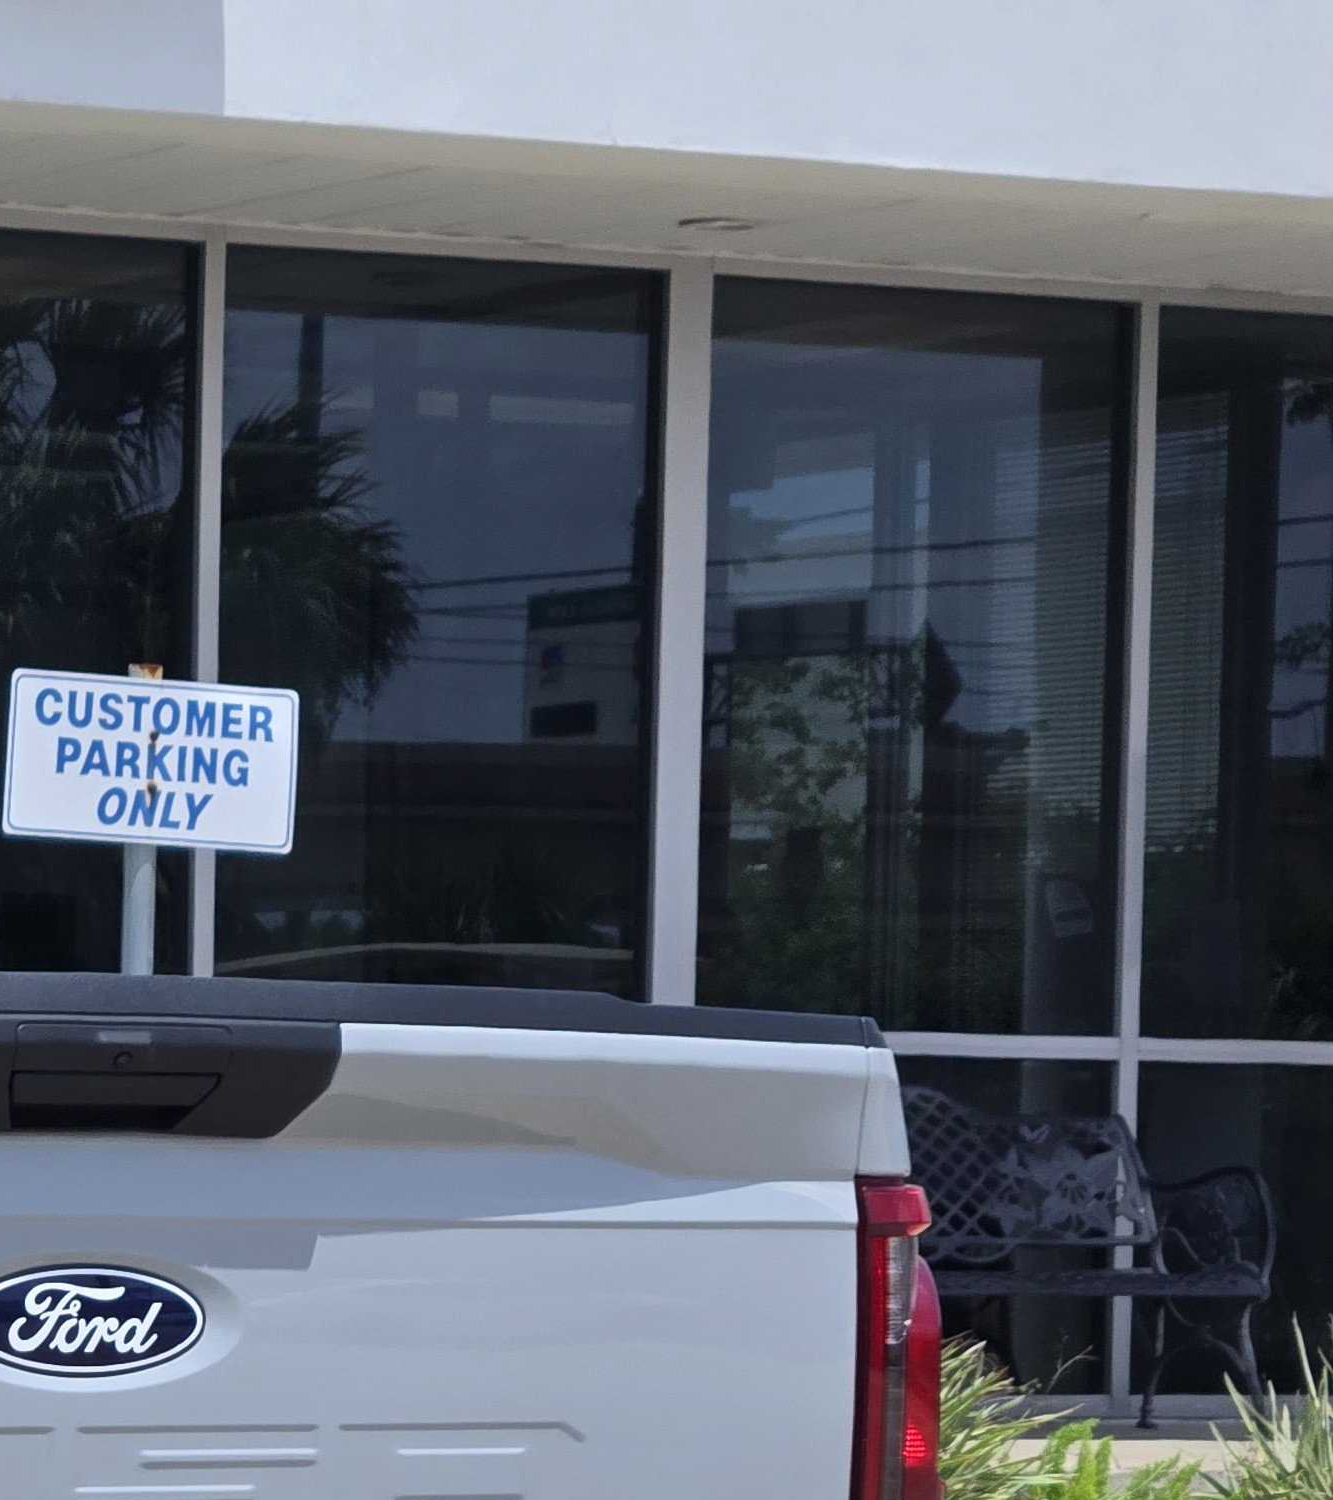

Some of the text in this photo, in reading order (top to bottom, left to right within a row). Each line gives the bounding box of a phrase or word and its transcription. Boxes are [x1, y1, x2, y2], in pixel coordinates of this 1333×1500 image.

[35, 687, 273, 742] CUSTOMER
[55, 736, 249, 787] PARKING
[96, 786, 213, 830] ONLY
[7, 1281, 164, 1354] Ford
